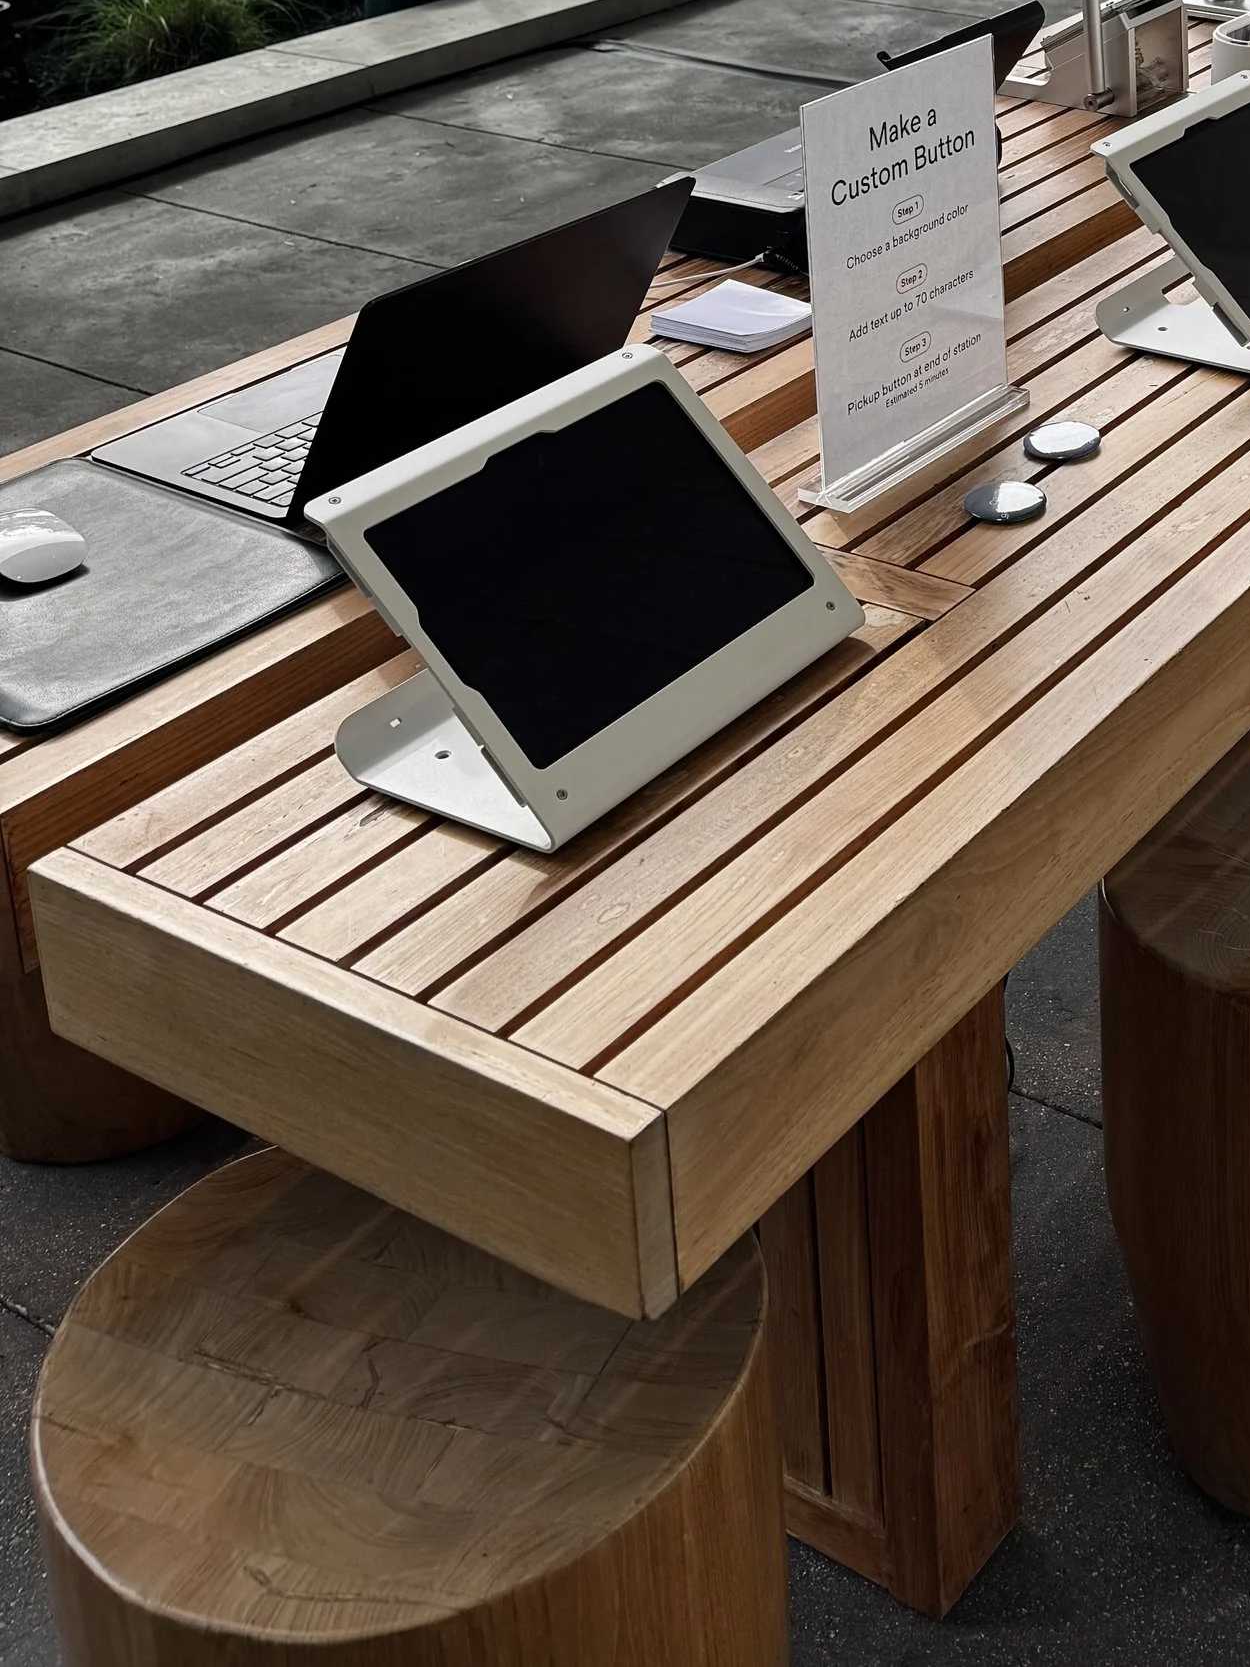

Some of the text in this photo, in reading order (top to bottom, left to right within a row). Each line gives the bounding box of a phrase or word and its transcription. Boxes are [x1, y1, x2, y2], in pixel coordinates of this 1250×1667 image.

[869, 108, 937, 151] Make a
[831, 158, 908, 206] Custom
[914, 130, 975, 170] Button
[897, 205, 914, 218] Step
[846, 204, 969, 269] Choose a background color
[900, 269, 923, 288] Step 2
[848, 270, 974, 342] Add text up to 70 characters
[904, 338, 927, 356] Step 3
[847, 333, 981, 415] Pickup button at end of station
[885, 367, 949, 408] Estimated 5 minutes
